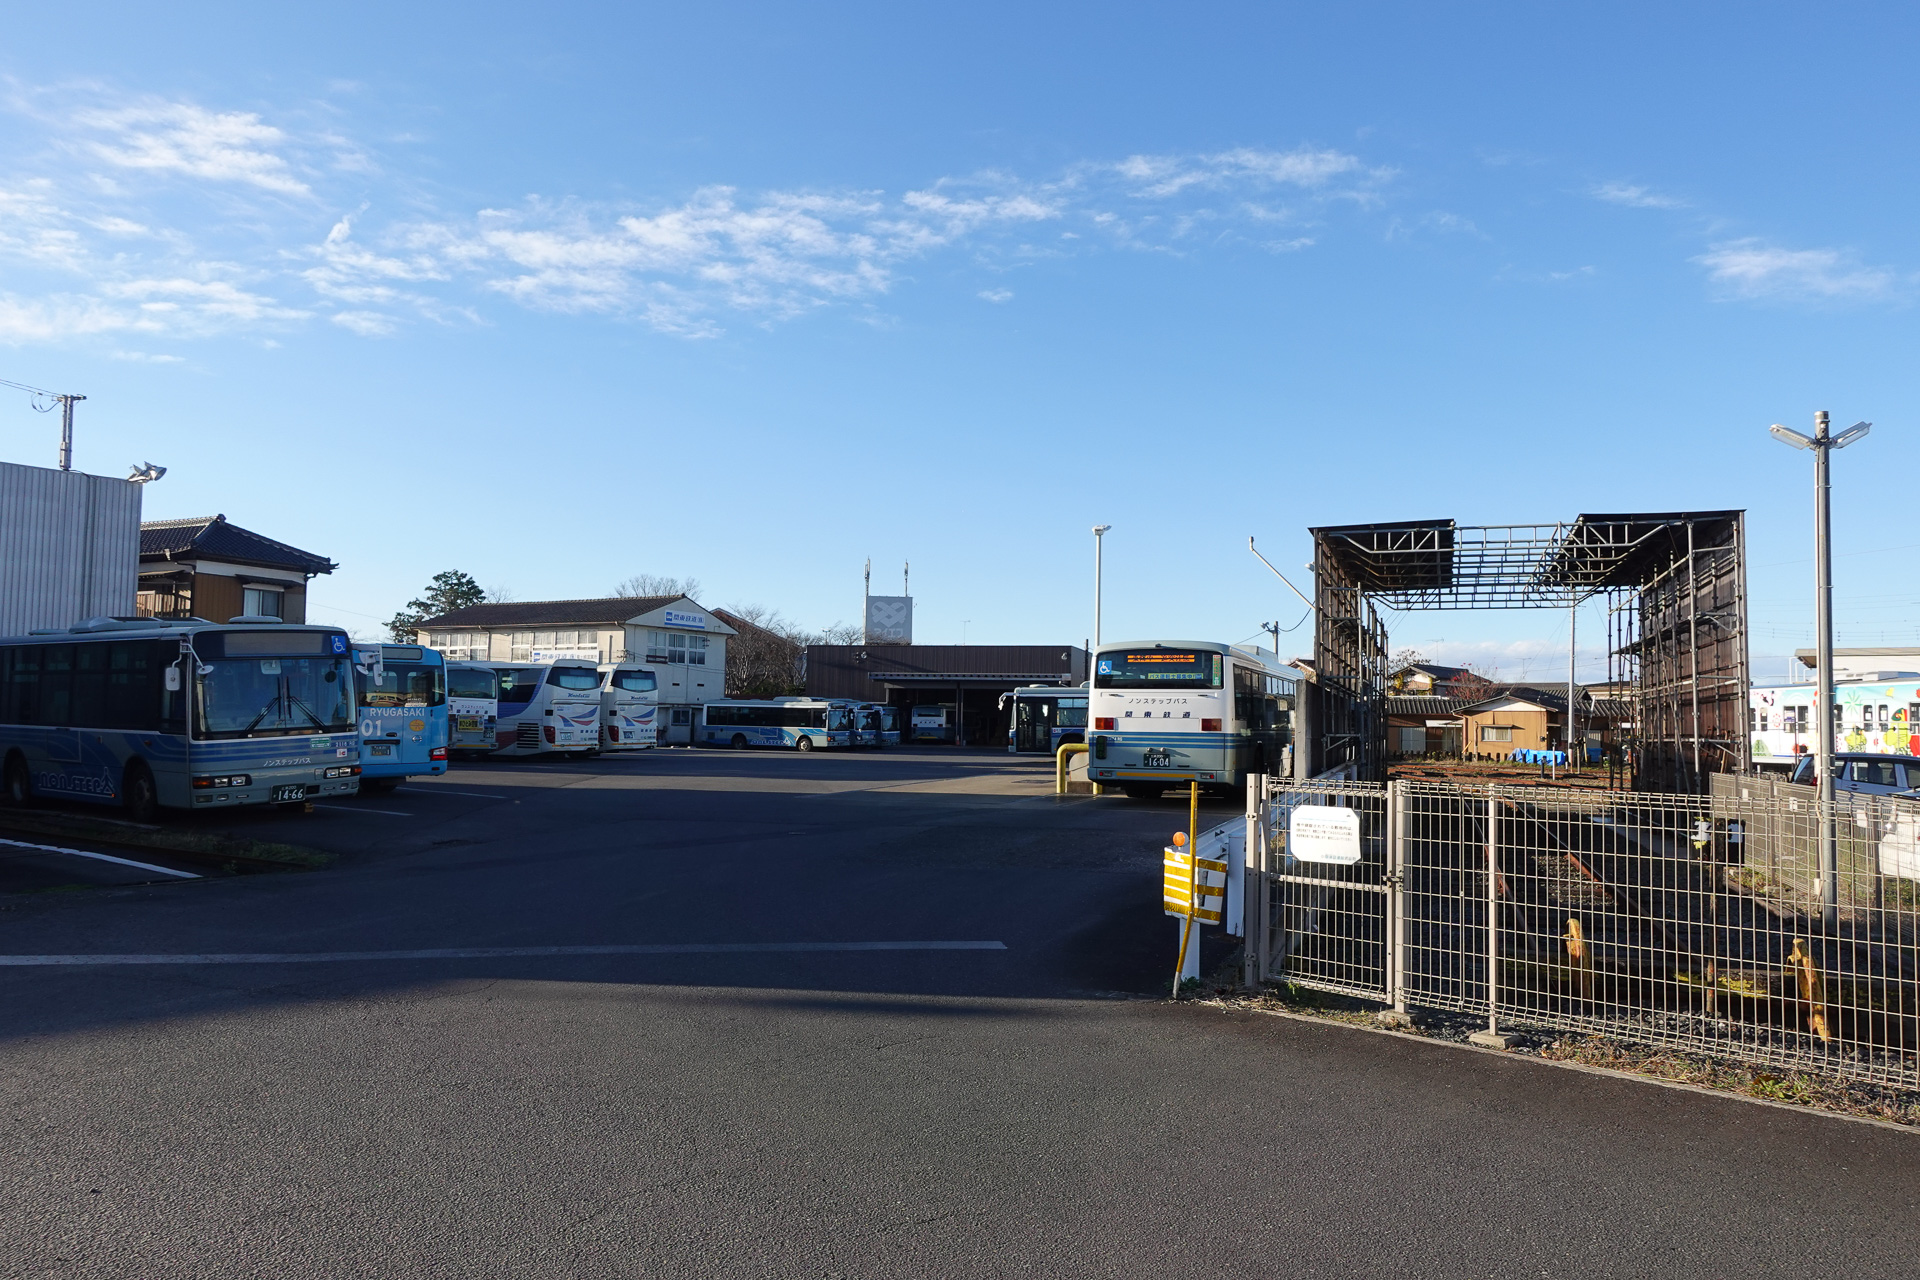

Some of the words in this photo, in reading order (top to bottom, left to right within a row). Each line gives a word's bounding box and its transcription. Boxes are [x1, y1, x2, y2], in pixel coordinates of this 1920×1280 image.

[369, 708, 425, 717] RYUGASAKI
[1125, 711, 1191, 719] 関東鉄道
[361, 719, 382, 737] 01
[263, 757, 312, 767] ノンステップバス
